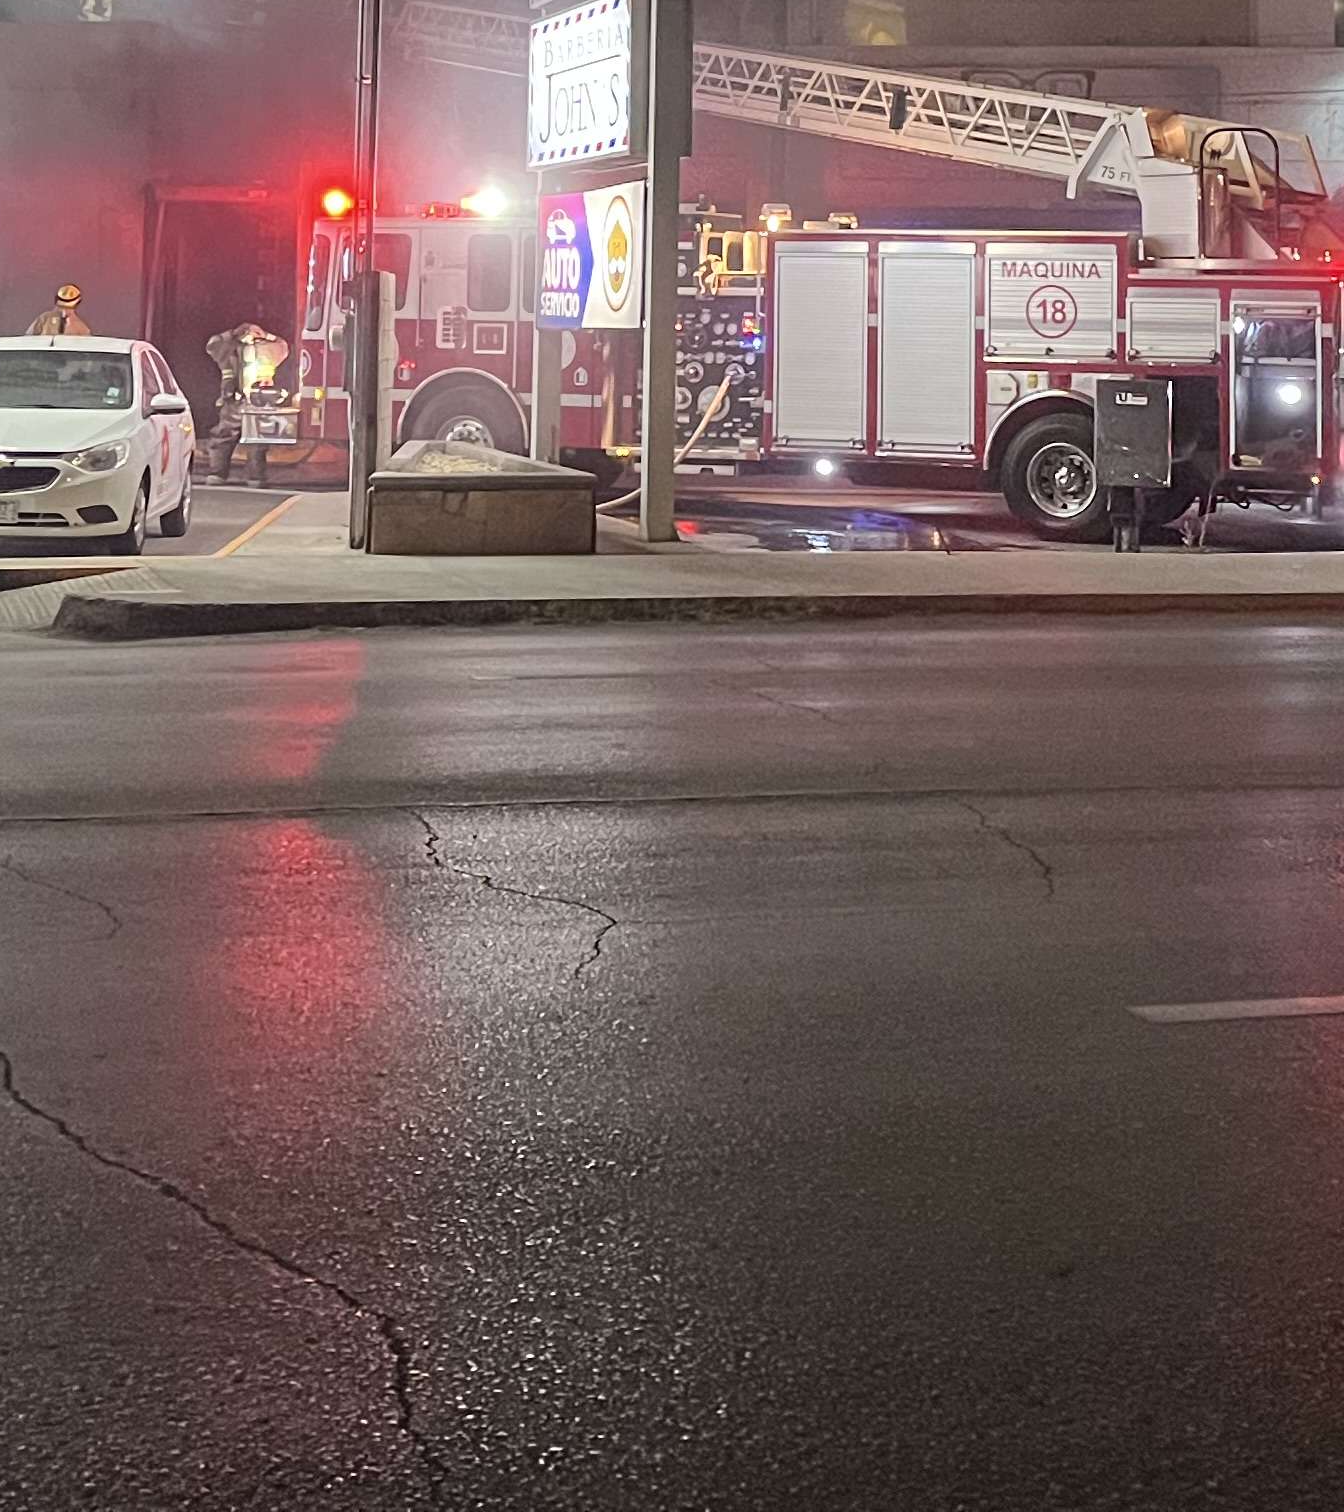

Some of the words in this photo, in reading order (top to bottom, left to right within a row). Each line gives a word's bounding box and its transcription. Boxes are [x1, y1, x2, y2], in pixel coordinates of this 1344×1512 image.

[1101, 165, 1116, 180] 75
[542, 247, 581, 290] AUTO
[1001, 261, 1102, 279] MAQUINA
[540, 291, 580, 318] SERVICIO
[1036, 298, 1067, 324] 18
